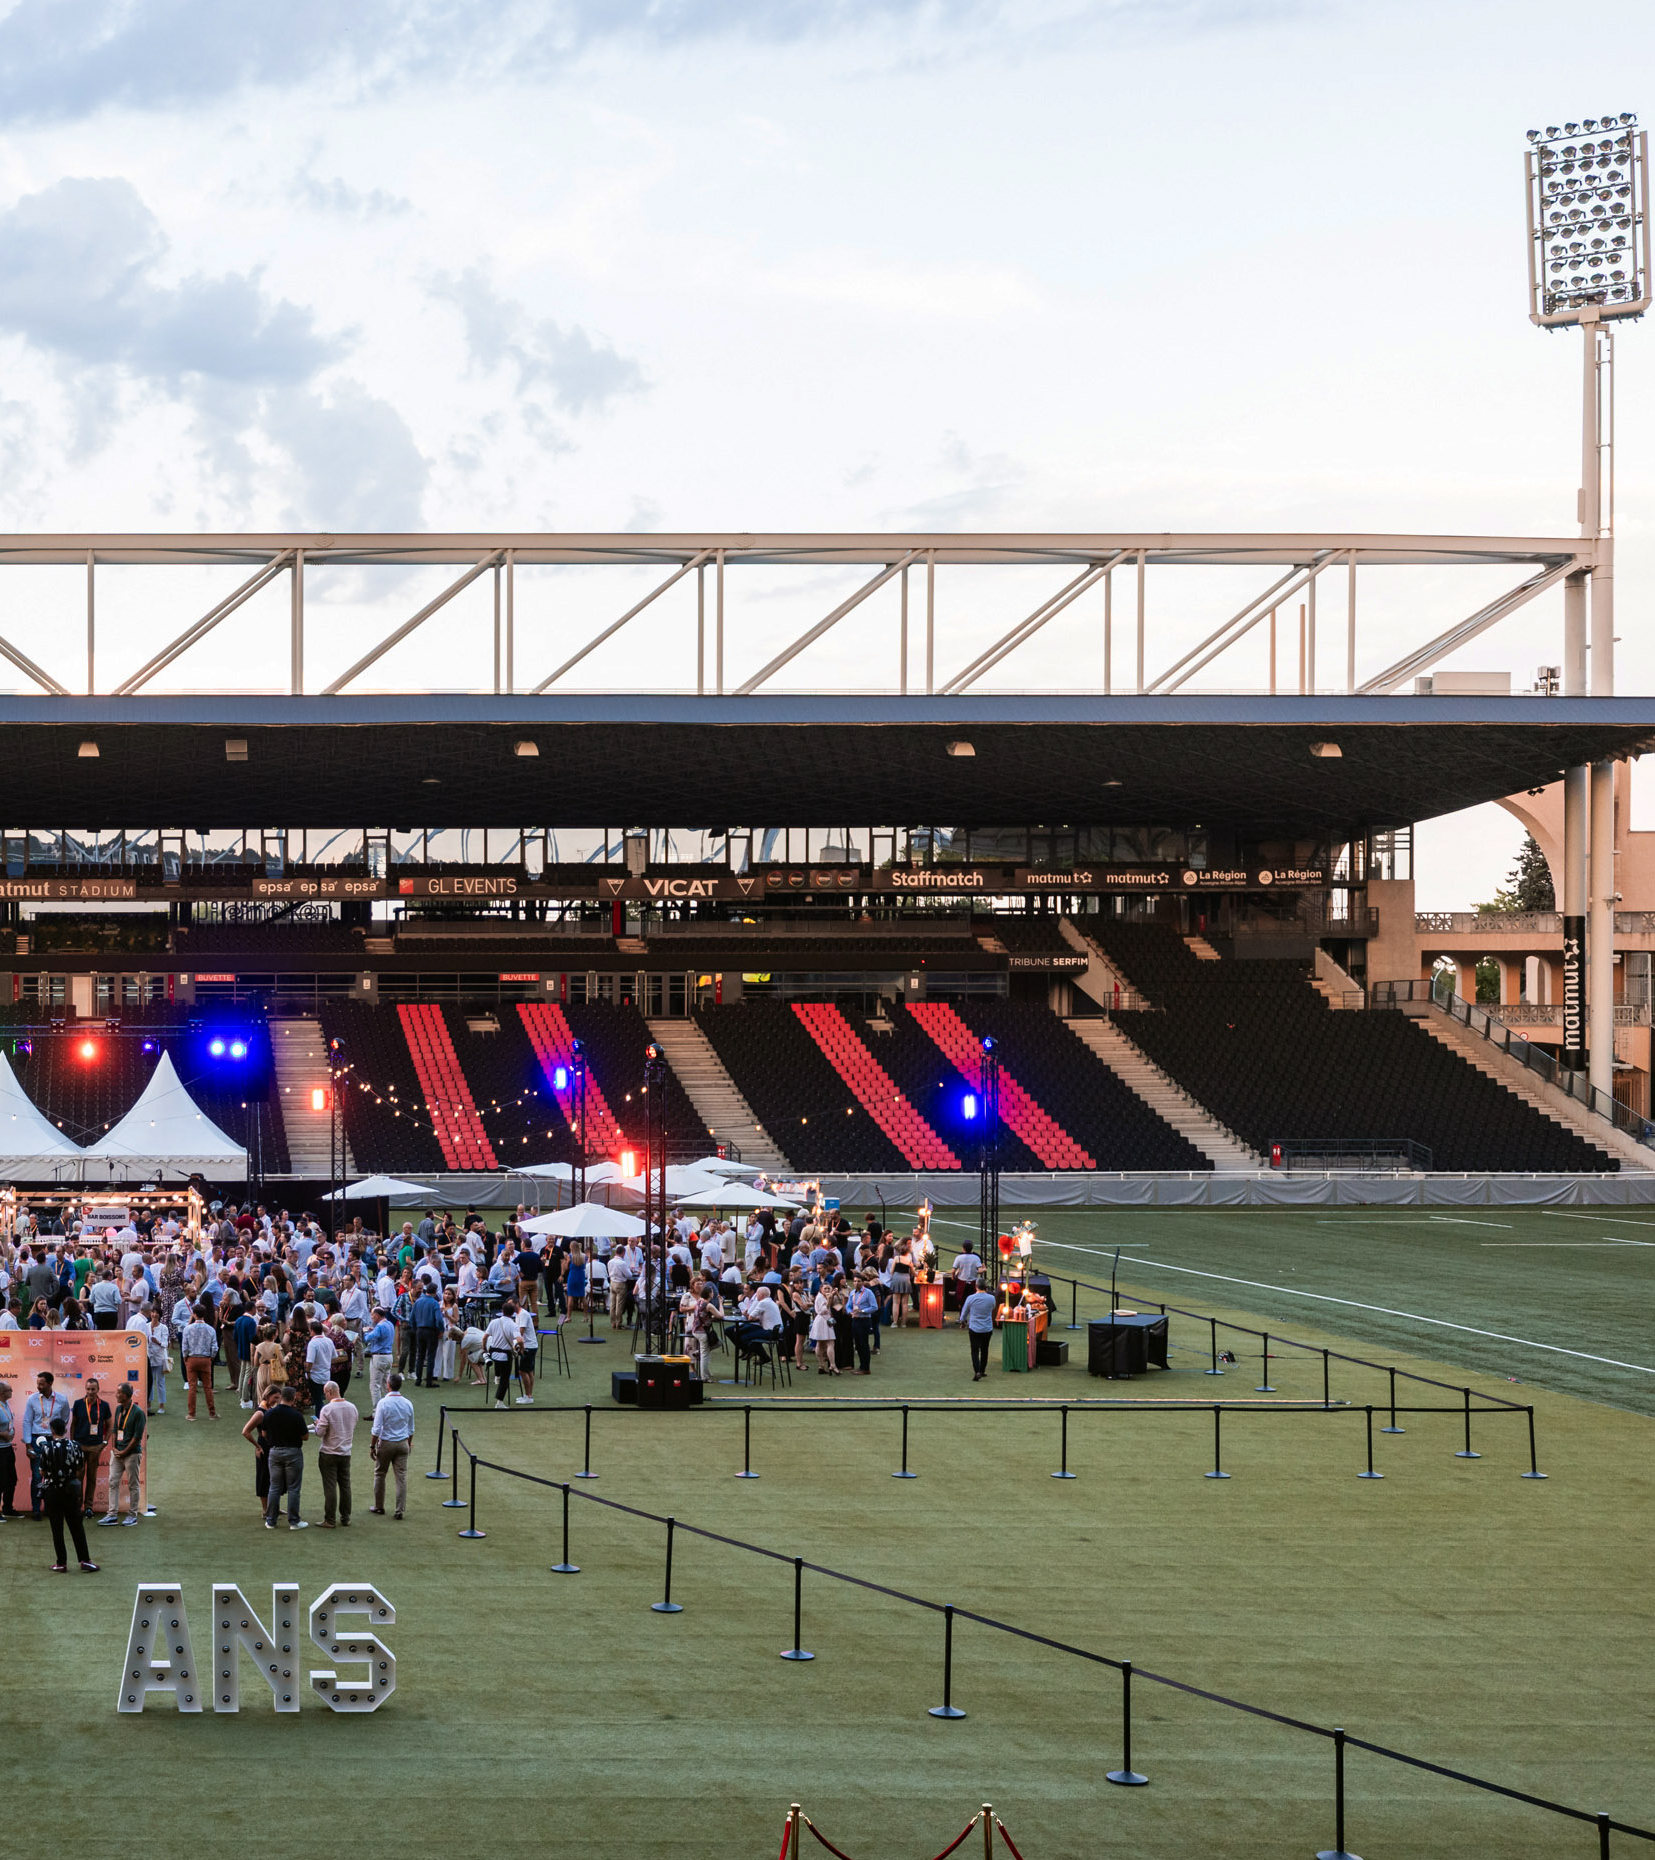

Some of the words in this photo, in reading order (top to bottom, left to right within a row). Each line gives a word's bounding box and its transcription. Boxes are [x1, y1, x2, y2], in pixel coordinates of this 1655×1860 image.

[891, 871, 984, 887] Staffmatch
[1027, 872, 1080, 885] matmut
[1106, 872, 1157, 885] matmut
[1199, 871, 1211, 880] La
[1212, 870, 1247, 882] Région
[1274, 871, 1286, 880] La
[1288, 870, 1322, 881] Région
[59, 885, 134, 897] STADIUM
[259, 882, 291, 894] epsa
[345, 882, 376, 894] epsa
[428, 879, 450, 894] GL
[454, 878, 518, 894] EVENTS
[644, 879, 719, 896] VICAT
[1009, 957, 1051, 967] TRIBUNE
[1052, 957, 1089, 967] SERFIM
[198, 974, 232, 982] BUVETTE
[1564, 961, 1581, 1050] matmut
[117, 1581, 397, 1714] ANS
